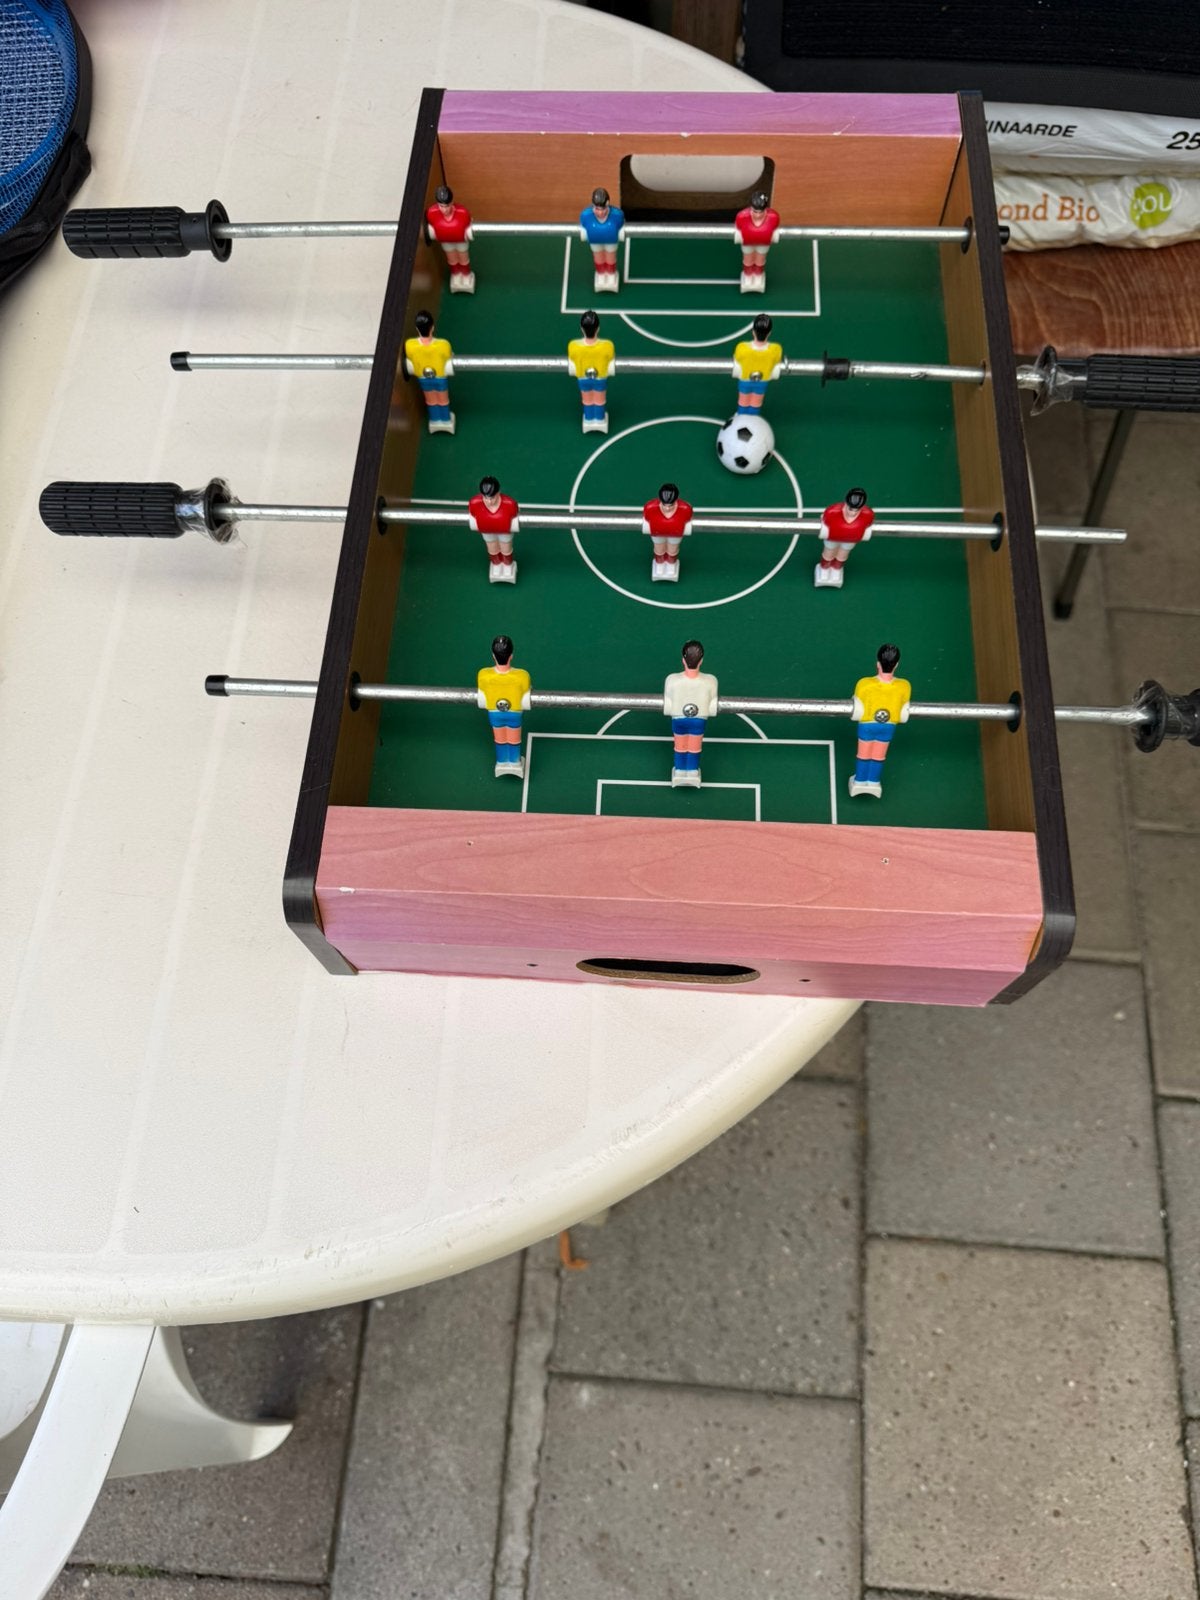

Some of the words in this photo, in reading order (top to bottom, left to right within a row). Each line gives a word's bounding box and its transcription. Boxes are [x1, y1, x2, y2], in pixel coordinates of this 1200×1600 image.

[984, 120, 1078, 138] INAARDE
[1166, 131, 1200, 150] 25
[1057, 196, 1100, 222] Bio
